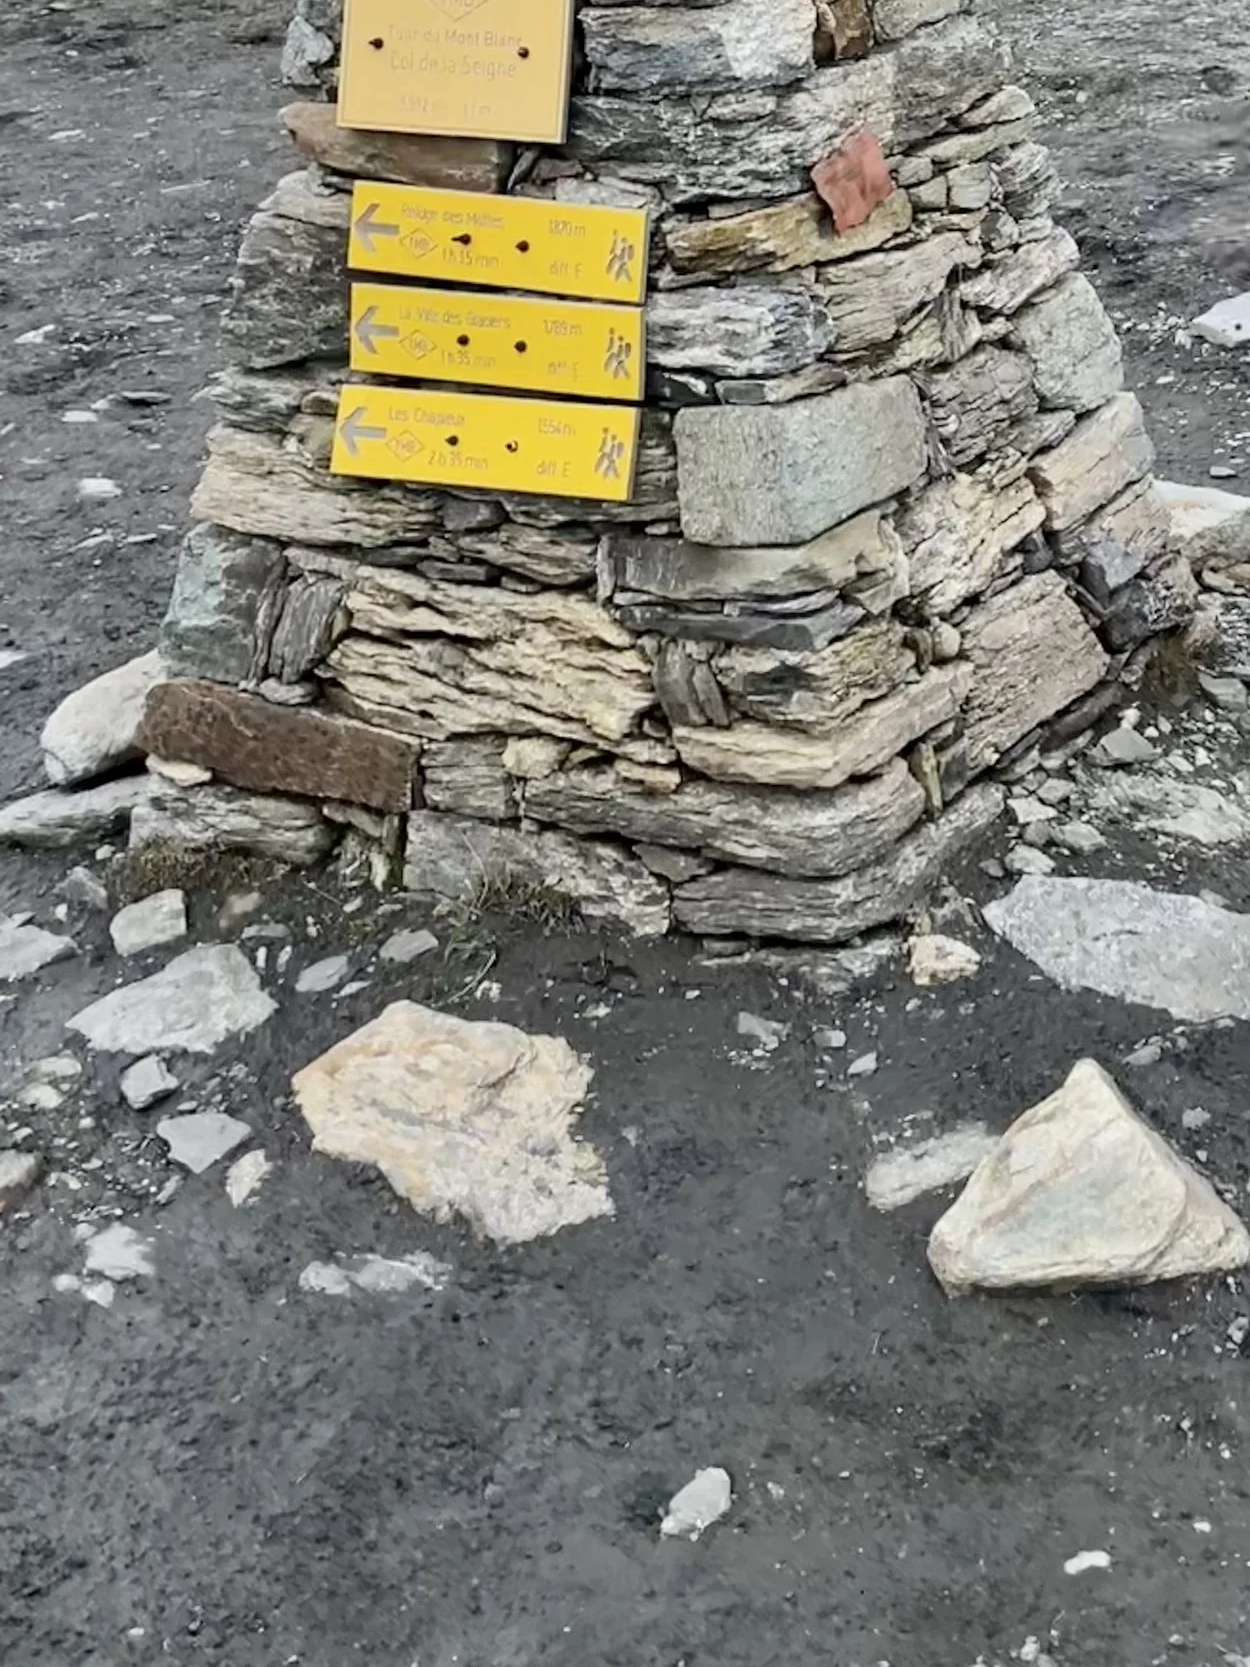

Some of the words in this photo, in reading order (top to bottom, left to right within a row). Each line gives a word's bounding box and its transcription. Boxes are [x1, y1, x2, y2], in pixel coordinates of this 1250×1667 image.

[445, 28, 480, 45] Mont
[484, 31, 523, 48] Blanc
[390, 51, 414, 71] Col
[419, 52, 438, 72] de
[442, 54, 456, 74] la
[462, 54, 517, 81] Seigne
[400, 306, 412, 321] La
[443, 311, 463, 326] des
[387, 405, 409, 422] Les
